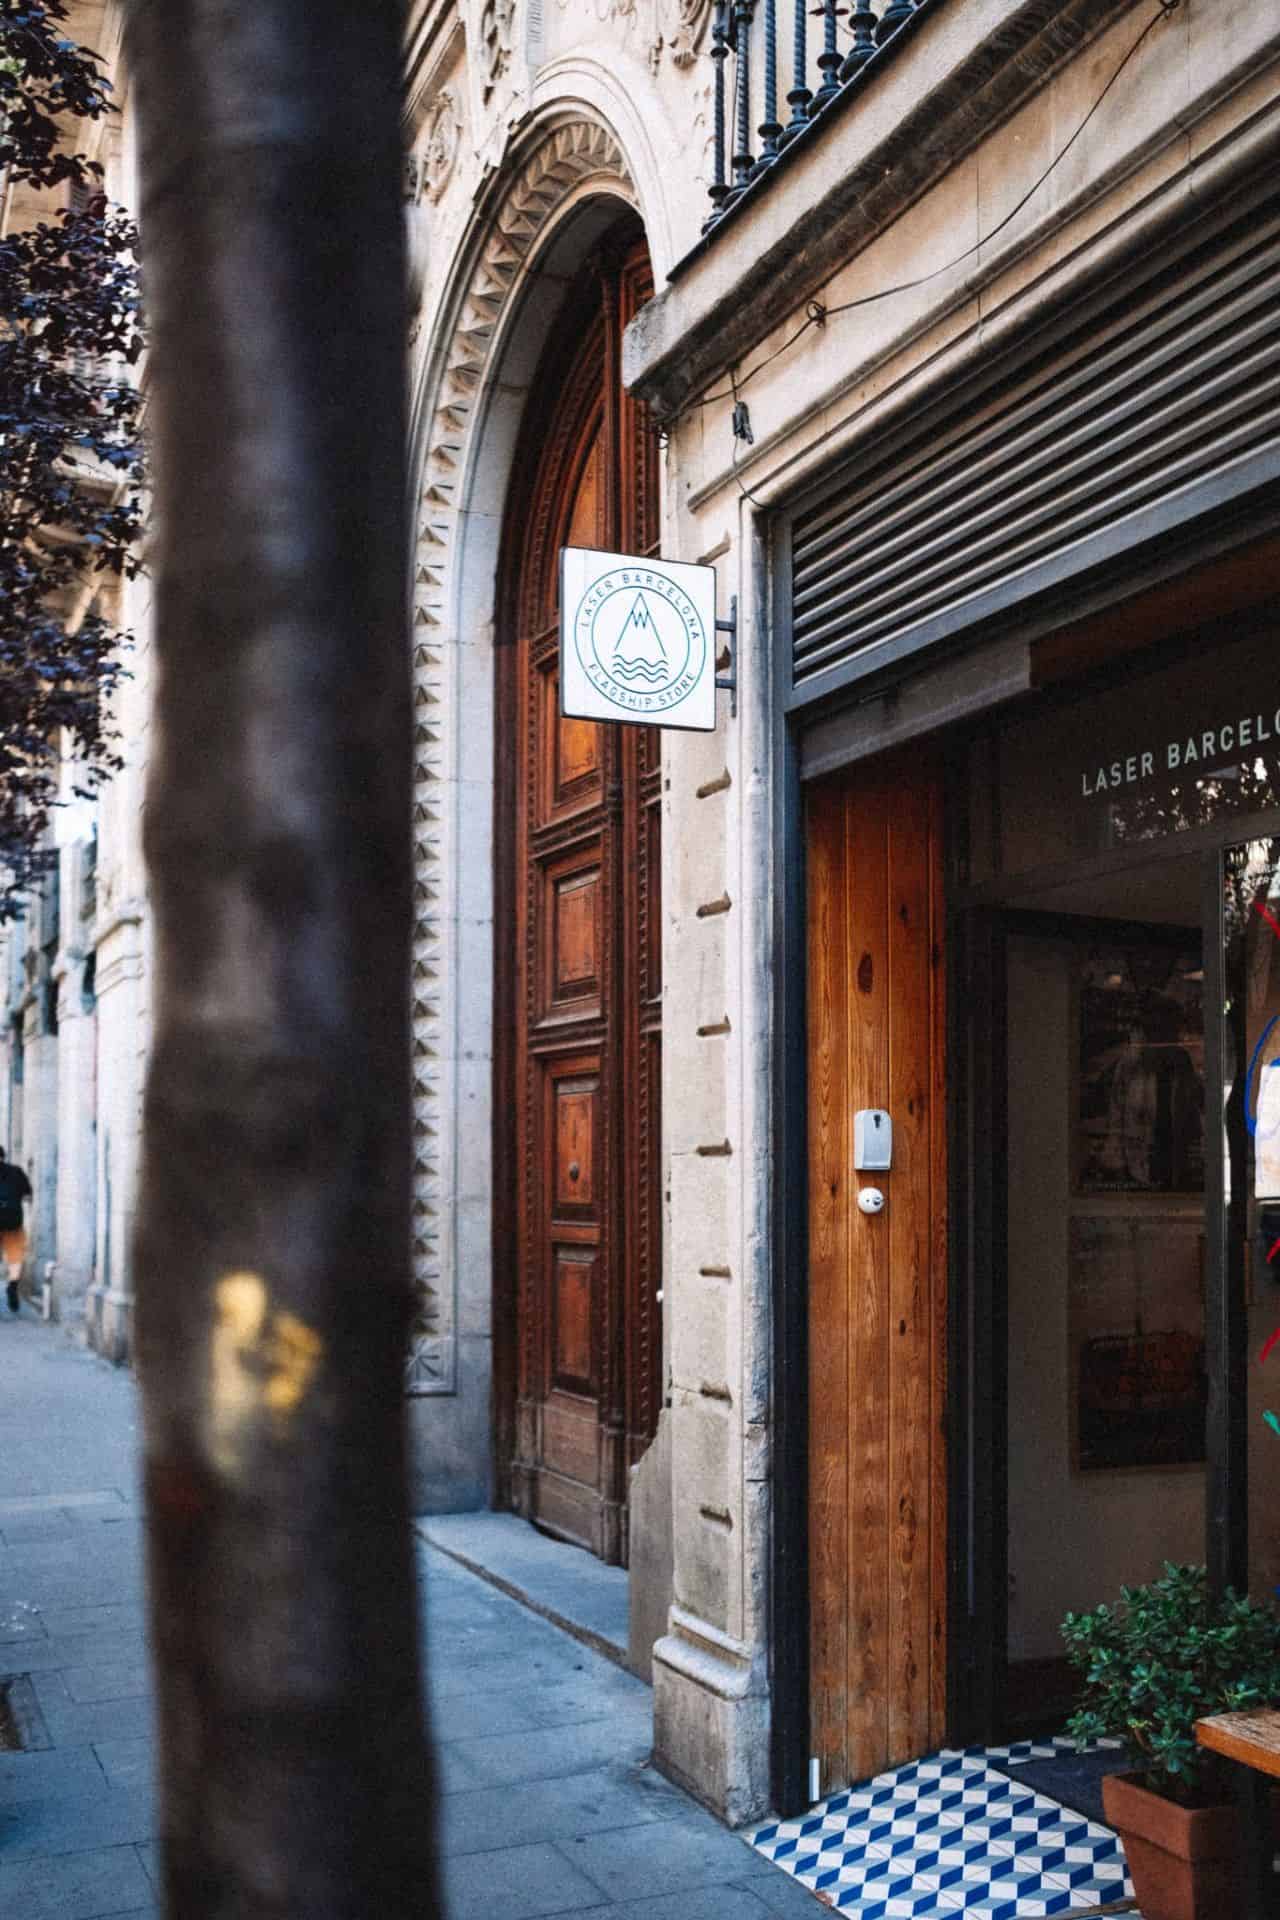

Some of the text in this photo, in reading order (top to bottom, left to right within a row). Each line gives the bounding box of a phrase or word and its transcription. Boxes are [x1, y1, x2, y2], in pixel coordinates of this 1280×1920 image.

[581, 574, 700, 640] LASER BARCELONA
[588, 663, 697, 707] FLAGSHIP STORE
[1082, 752, 1154, 796] LASER
